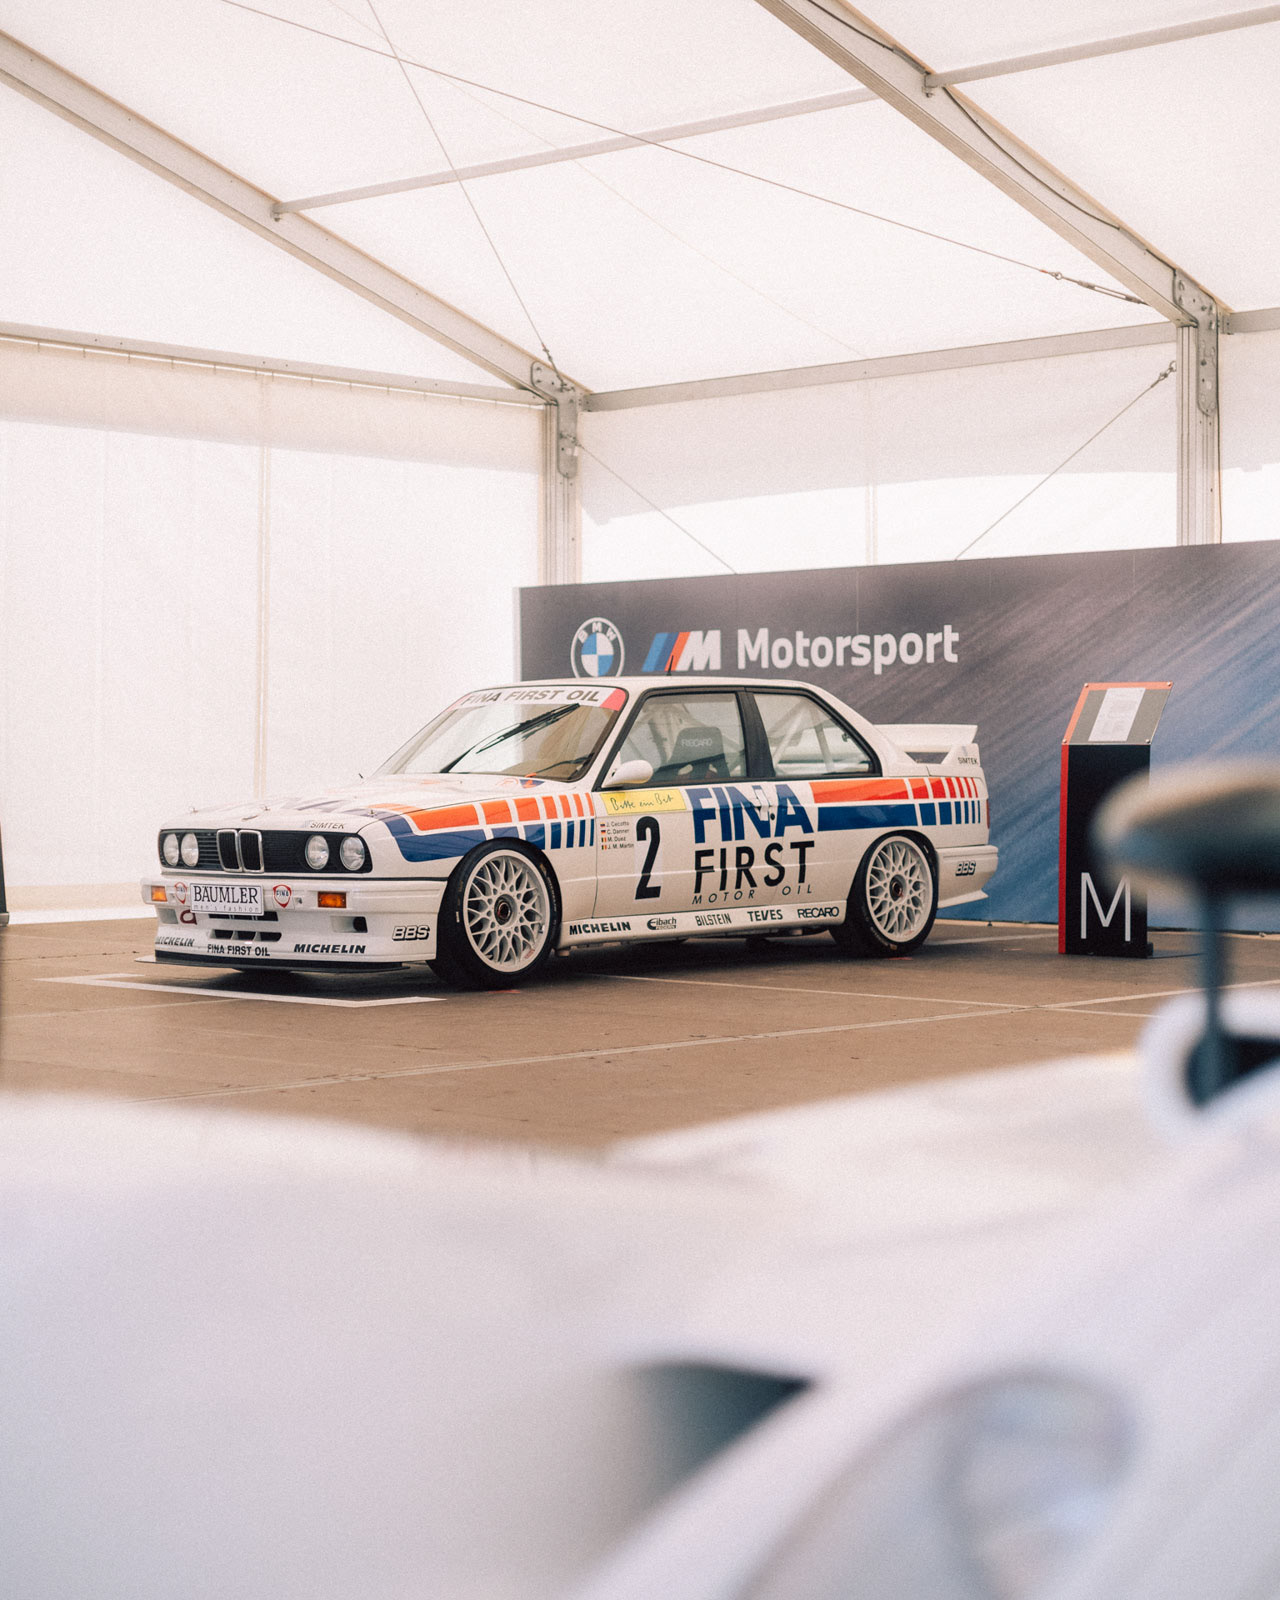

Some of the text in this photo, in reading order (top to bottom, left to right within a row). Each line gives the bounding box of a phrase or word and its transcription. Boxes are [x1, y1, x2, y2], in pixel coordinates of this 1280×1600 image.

[577, 621, 617, 644] BMW
[737, 624, 959, 675] Motorsport
[461, 690, 599, 706] FINA FIRST OIL
[685, 784, 814, 843] FINA
[310, 822, 345, 830] SIMTEK
[635, 816, 661, 900] 2
[694, 840, 815, 894] FIRST
[955, 860, 976, 876] BBS
[193, 885, 259, 904] BÄUMLER
[692, 885, 812, 905] MOTOR OIL
[797, 906, 840, 918] RECARO
[1081, 872, 1131, 941] M
[647, 917, 677, 930] Eibach
[694, 913, 732, 926] BILSTEIN
[747, 909, 783, 922] TEVES
[392, 925, 430, 941] BBS
[569, 921, 631, 935] MICHELIN
[227, 945, 252, 955] FIRST
[254, 946, 270, 956] OIL
[293, 943, 366, 954] MICHELIN
